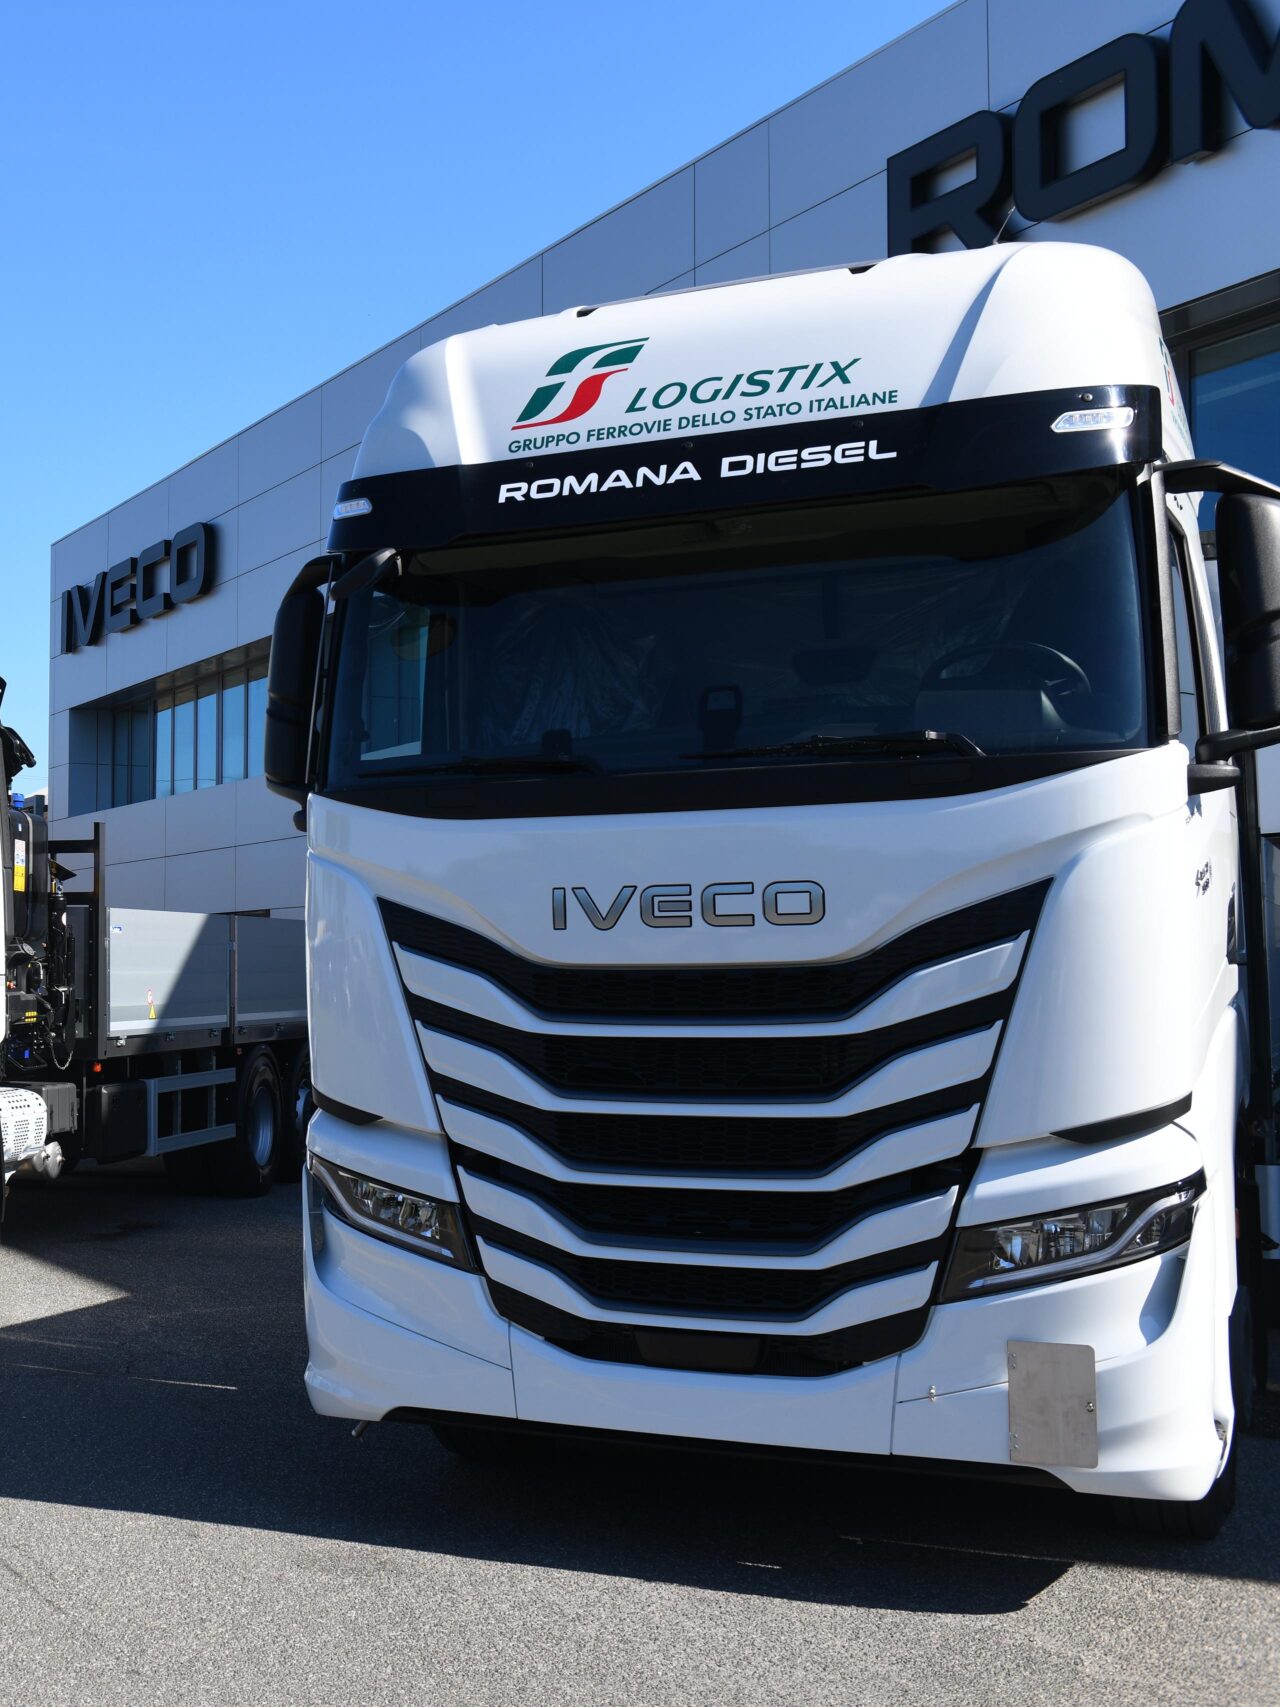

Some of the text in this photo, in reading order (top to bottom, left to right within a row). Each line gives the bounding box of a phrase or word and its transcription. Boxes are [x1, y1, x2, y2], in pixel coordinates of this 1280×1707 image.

[624, 357, 863, 414] LOGISTIX
[508, 389, 898, 454] GRUPPO FERROVIE DELLO STATO ITALIANE
[497, 439, 898, 503] ROMANA DIESEL
[61, 522, 213, 655] IVECO
[552, 880, 826, 931] IVECO
